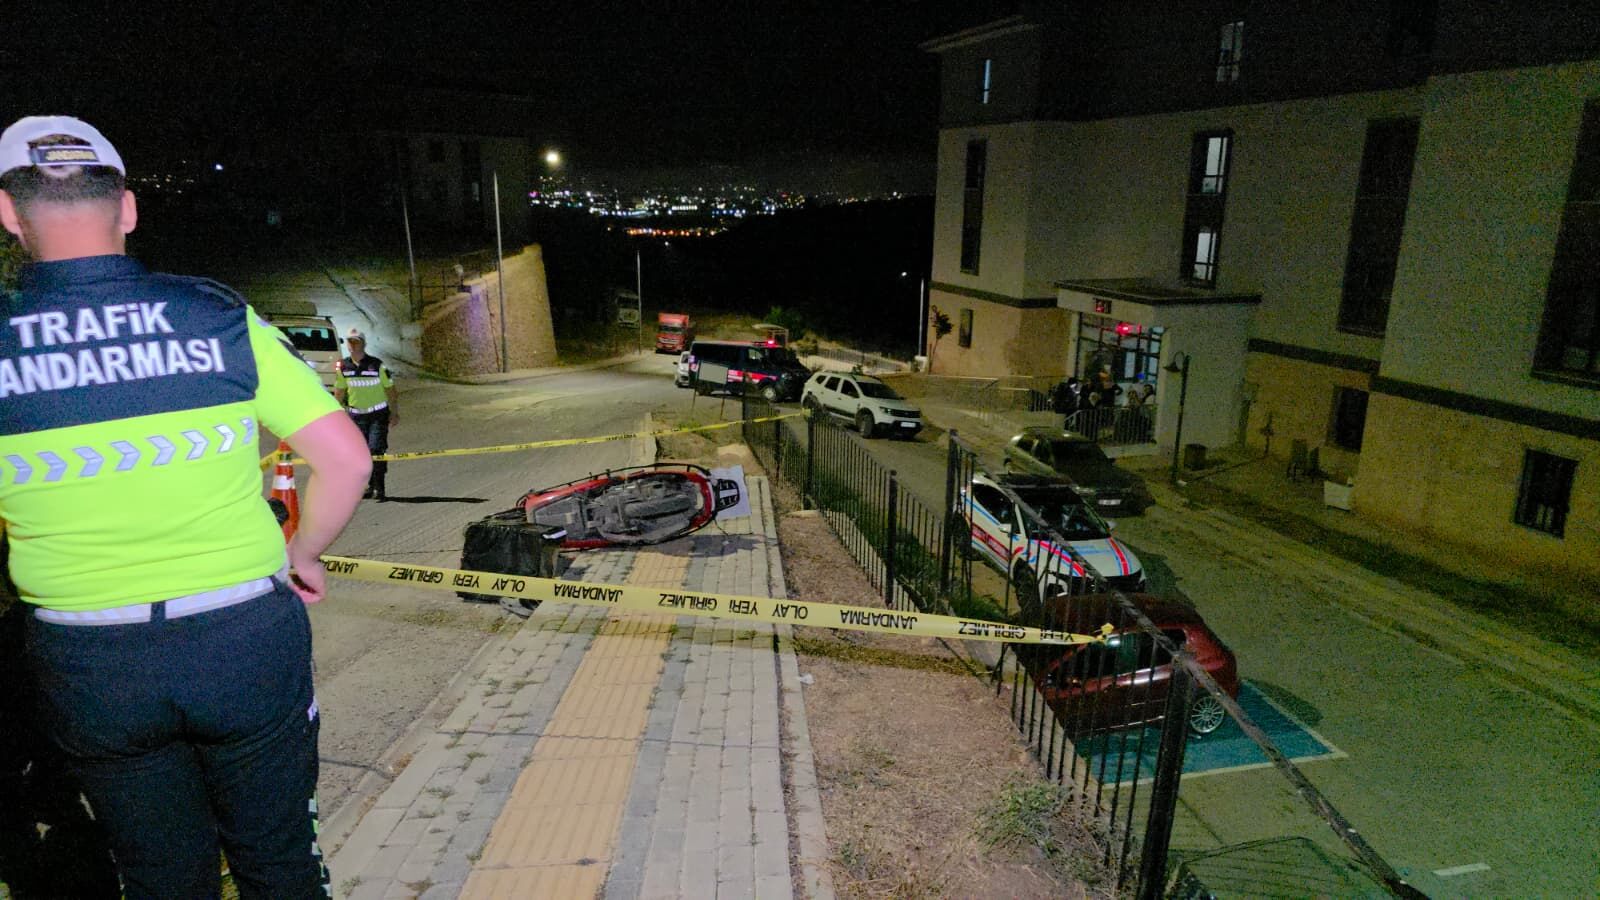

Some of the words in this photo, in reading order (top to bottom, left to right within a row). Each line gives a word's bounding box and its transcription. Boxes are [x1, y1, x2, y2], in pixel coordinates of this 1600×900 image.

[491, 577, 526, 593] OLAY
[553, 583, 624, 603] JANDARMA
[771, 603, 809, 620] OLAY
[840, 609, 918, 630] JANDARMA
